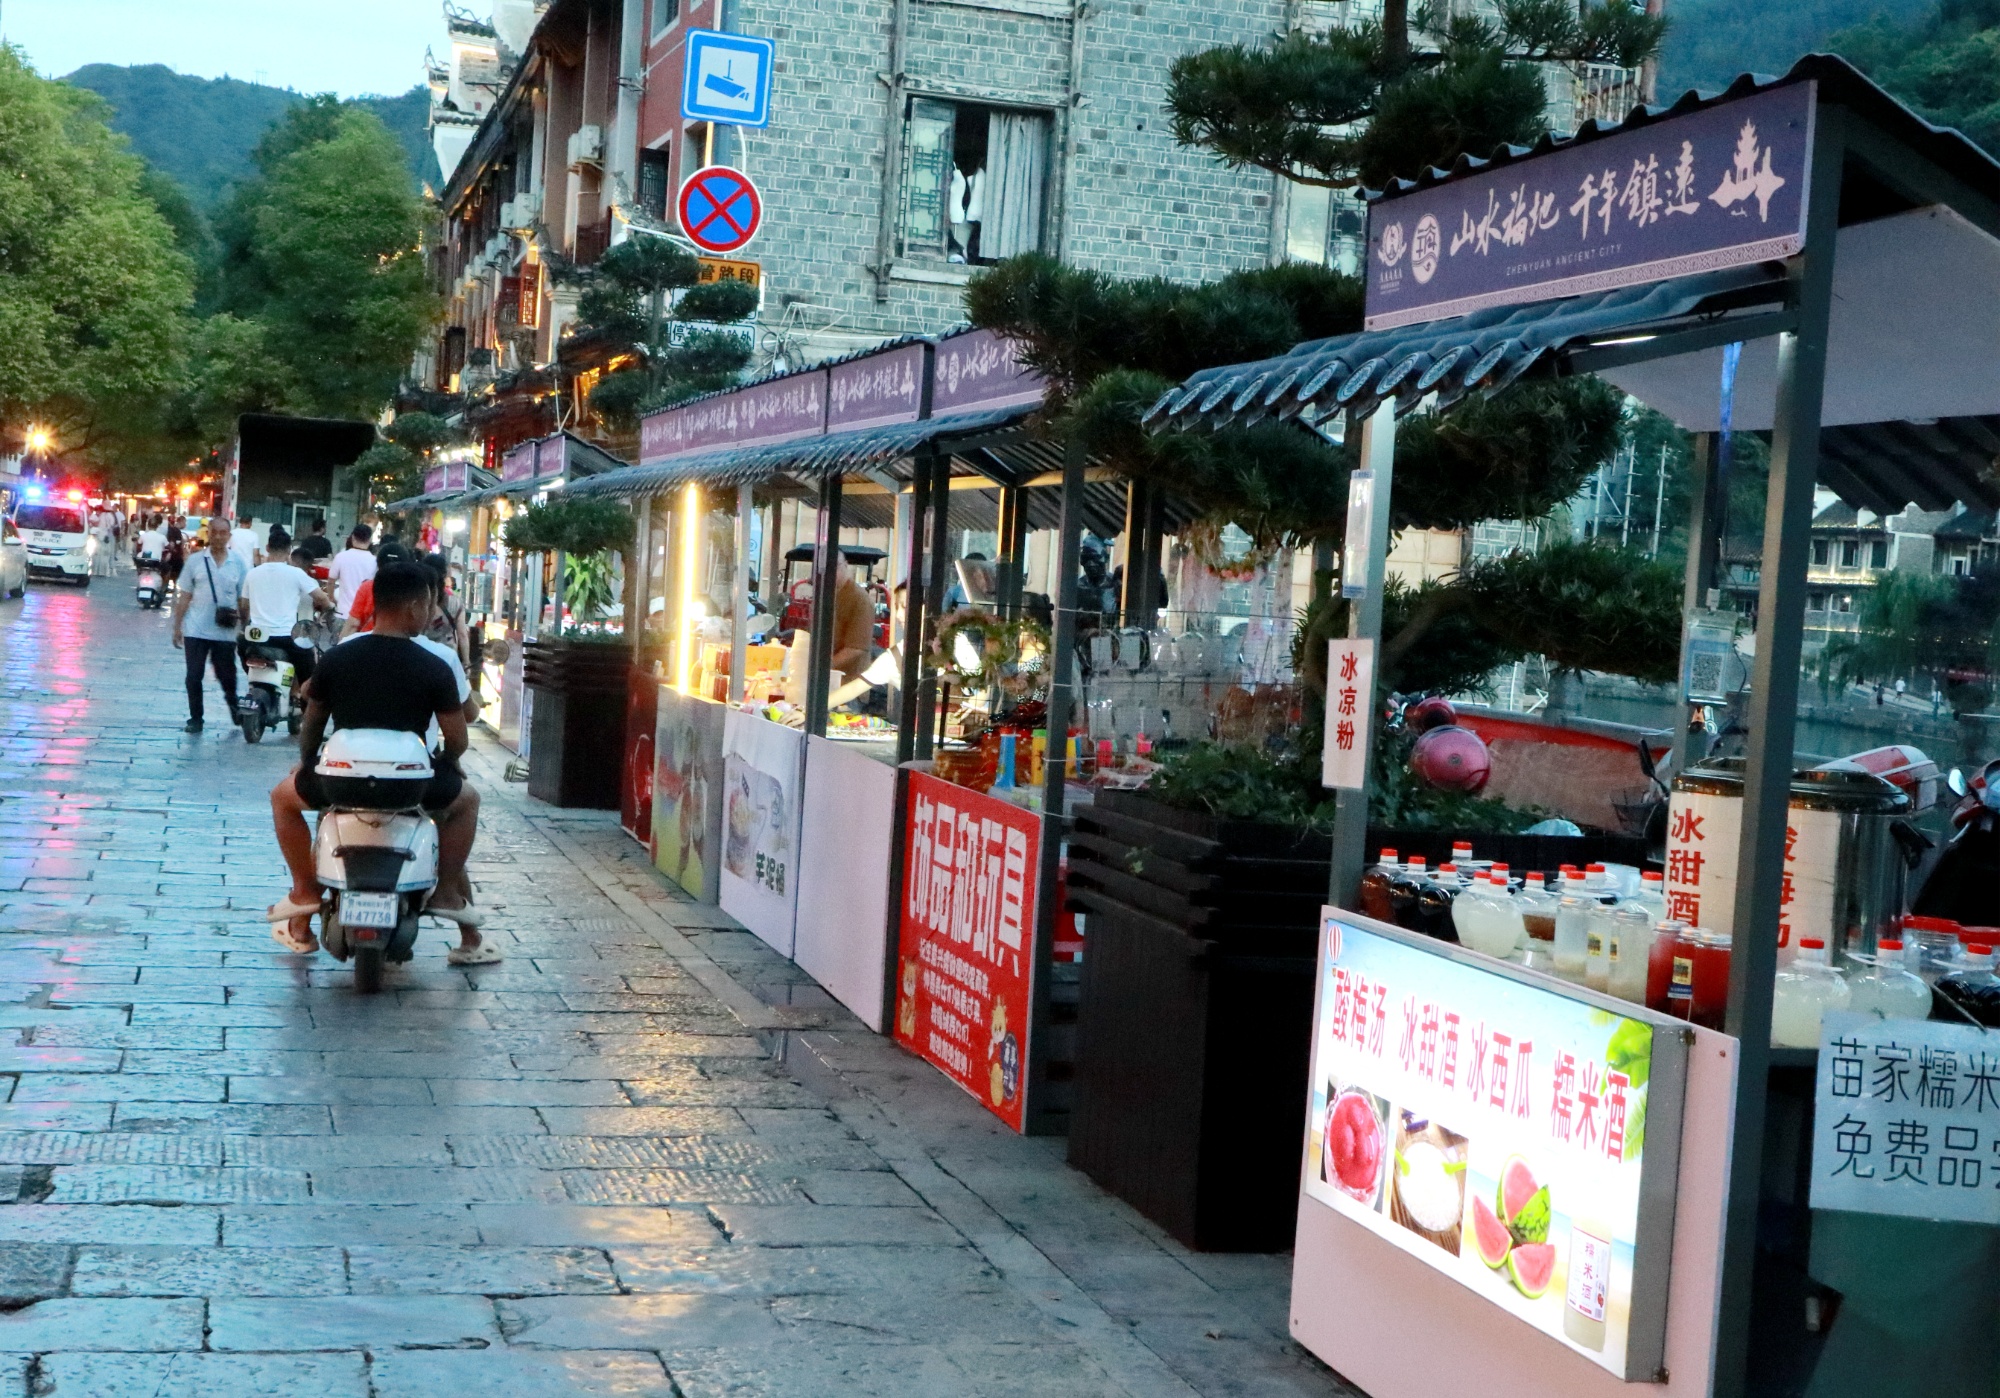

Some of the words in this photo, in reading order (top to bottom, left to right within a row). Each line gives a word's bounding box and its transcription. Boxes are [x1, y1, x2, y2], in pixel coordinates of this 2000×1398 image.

[700, 263, 755, 284] 管路段
[1506, 256, 1552, 277] ZHENYUAN
[1555, 249, 1597, 266] ANCIENT
[1599, 243, 1622, 258] CITY
[1336, 651, 1358, 750] 冰凉粉
[908, 792, 1029, 977] 饰品和玩具
[1666, 808, 1705, 928] 冰甜酒
[1331, 969, 1387, 1059] 酸梅汤
[1400, 995, 1460, 1092] 冰甜酒
[1466, 1021, 1534, 1121] 冰西瓜
[1550, 1048, 1630, 1165] 糯米酒
[1830, 1036, 2000, 1113] 苗家糯米
[1830, 1113, 2000, 1190] 免费品
